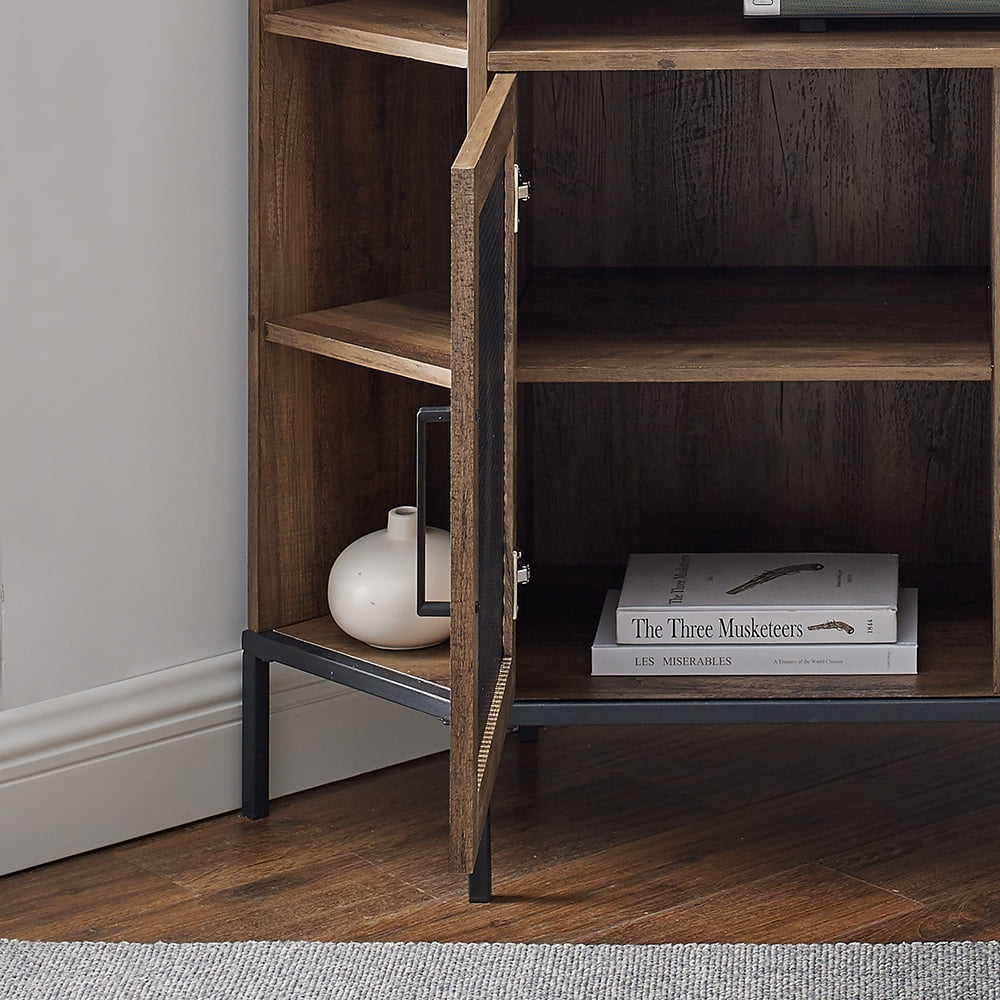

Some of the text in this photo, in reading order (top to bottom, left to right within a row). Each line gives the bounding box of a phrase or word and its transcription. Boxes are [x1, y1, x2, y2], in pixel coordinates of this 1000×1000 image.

[631, 617, 803, 639] The Three Musketeers
[634, 656, 732, 667] LES MISERABLES
